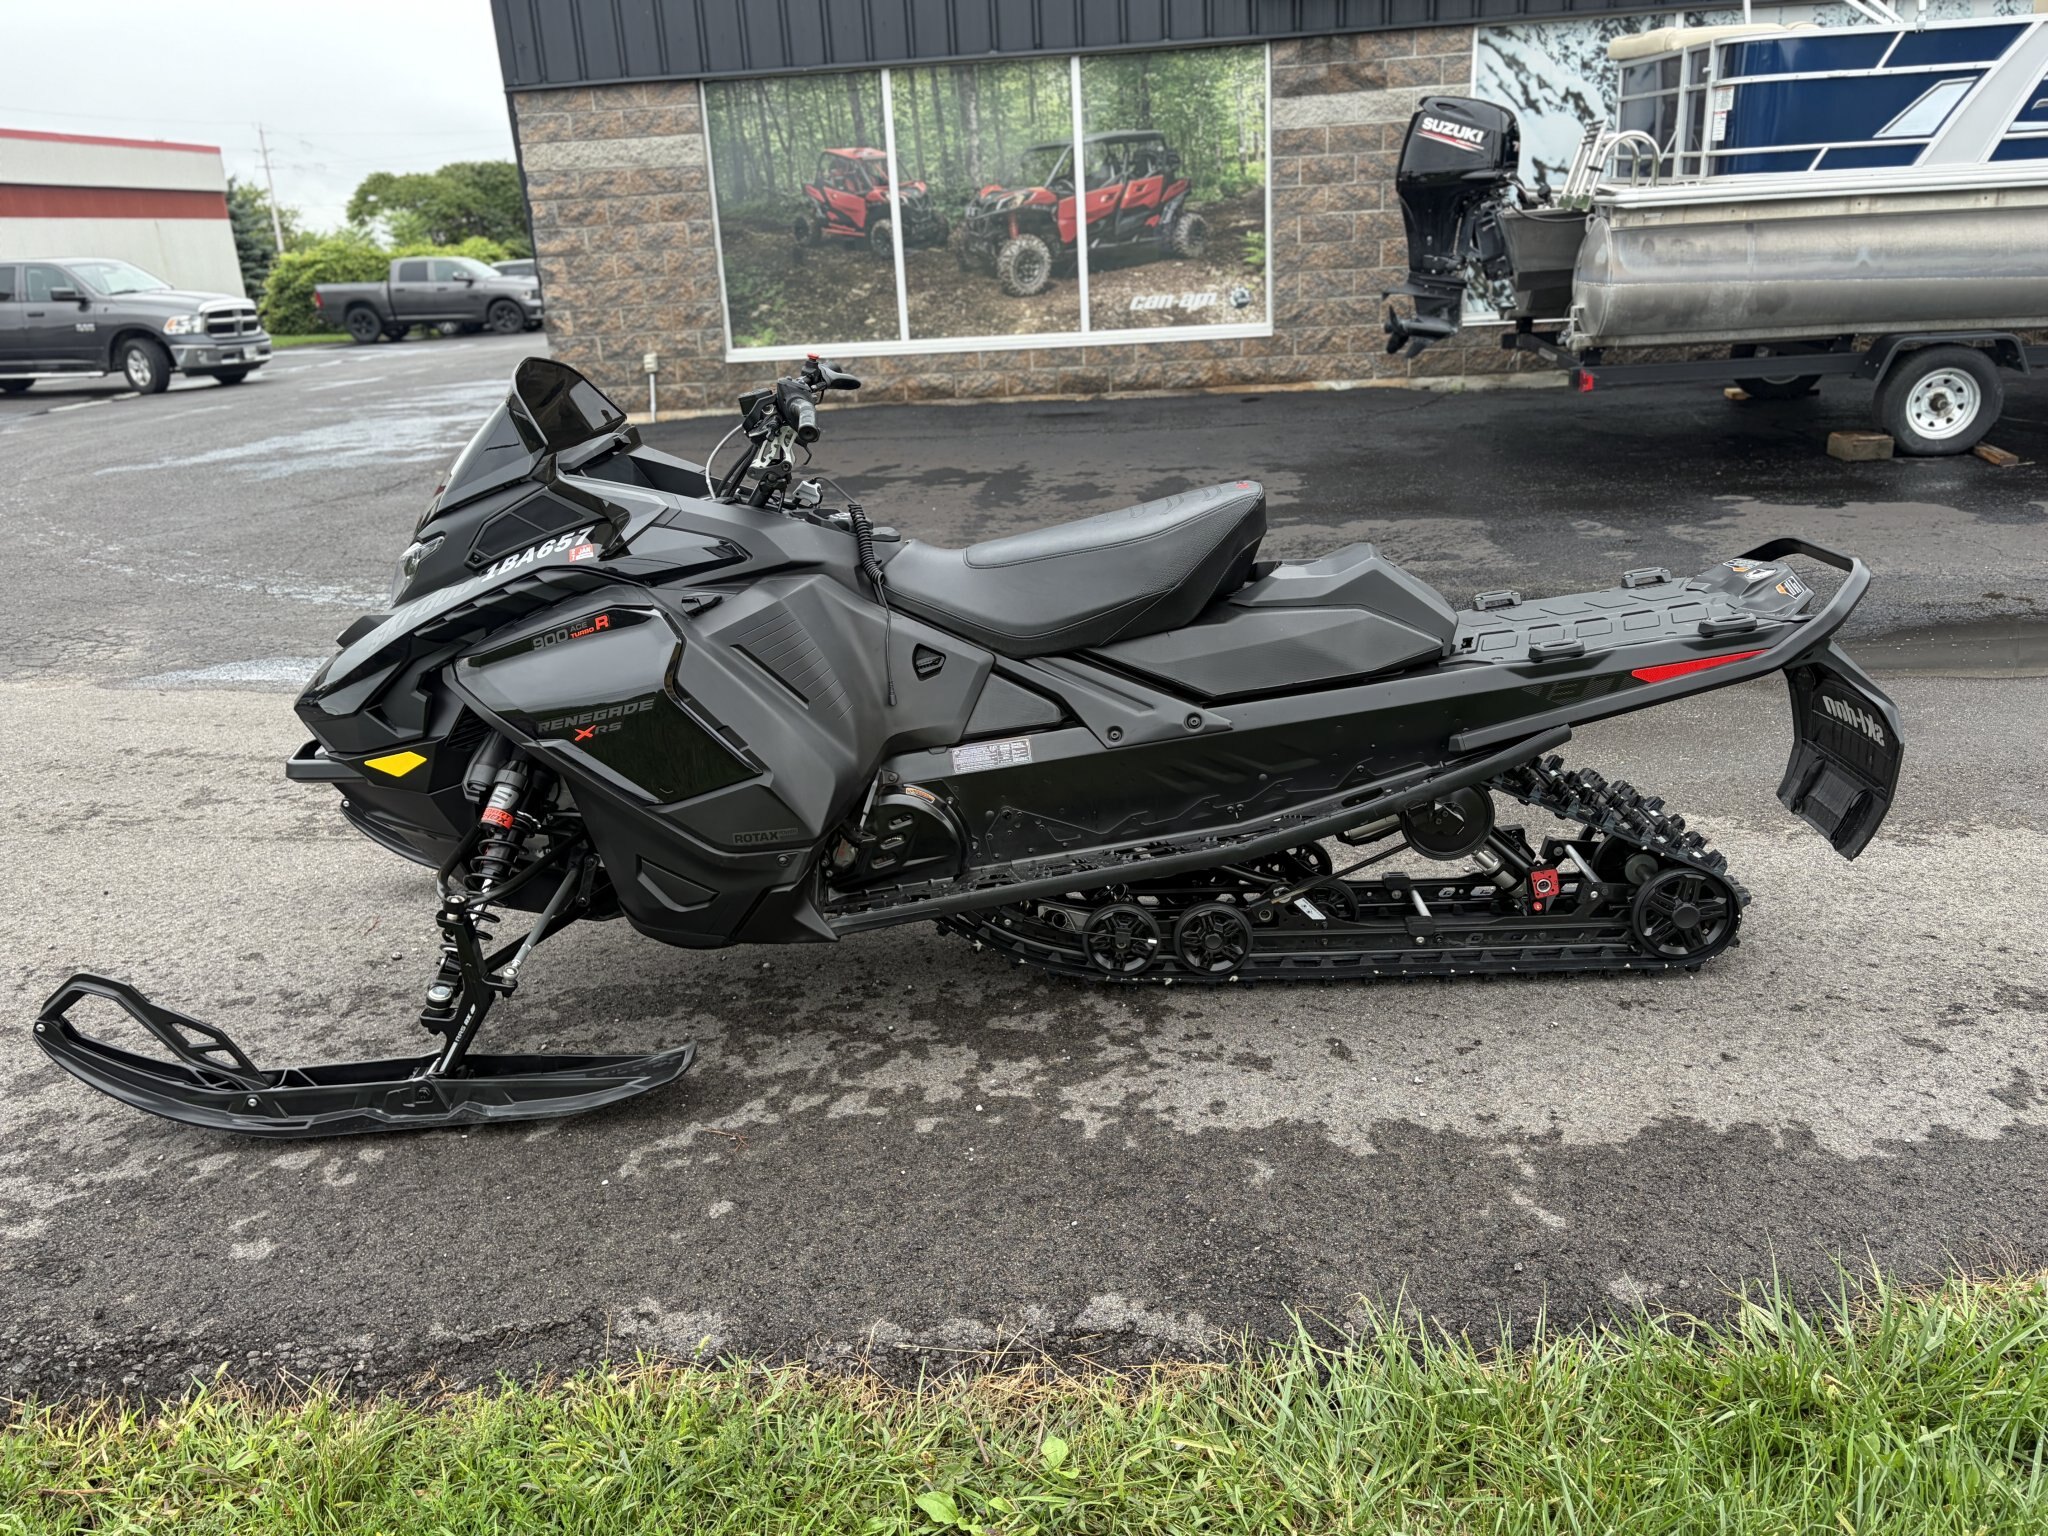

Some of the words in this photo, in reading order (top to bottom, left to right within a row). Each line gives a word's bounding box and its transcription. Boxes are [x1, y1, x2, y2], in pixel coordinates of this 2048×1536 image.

[1422, 117, 1485, 144] SUZUKI
[1129, 292, 1218, 314] can-am
[481, 525, 595, 583] 1BA657
[532, 628, 569, 651] 900
[569, 621, 588, 633] ACE
[594, 614, 610, 631] R
[569, 626, 595, 639] TURBO
[537, 697, 656, 733] RENEGADE
[734, 831, 779, 844] ROTAX
